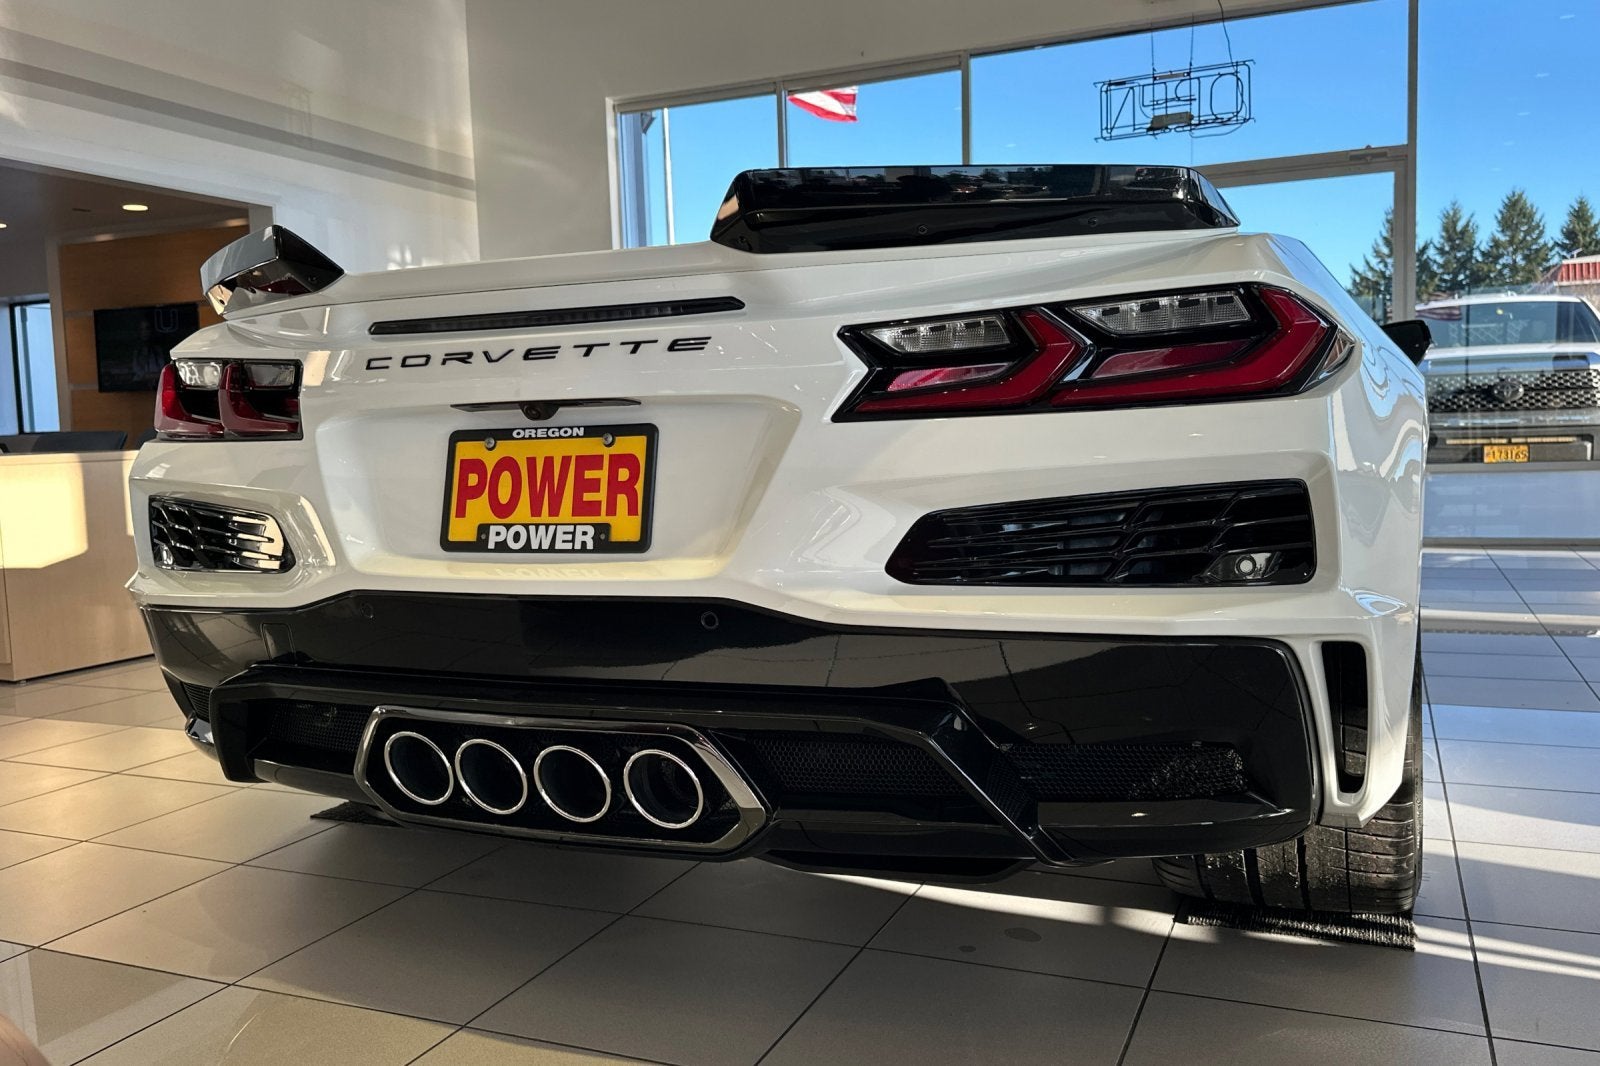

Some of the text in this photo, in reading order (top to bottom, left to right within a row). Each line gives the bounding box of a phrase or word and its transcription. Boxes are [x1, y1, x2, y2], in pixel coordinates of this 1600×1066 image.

[365, 336, 712, 370] CORVETTE
[512, 427, 585, 438] OREGON
[455, 453, 641, 519] POWER
[487, 524, 595, 550] POWER
